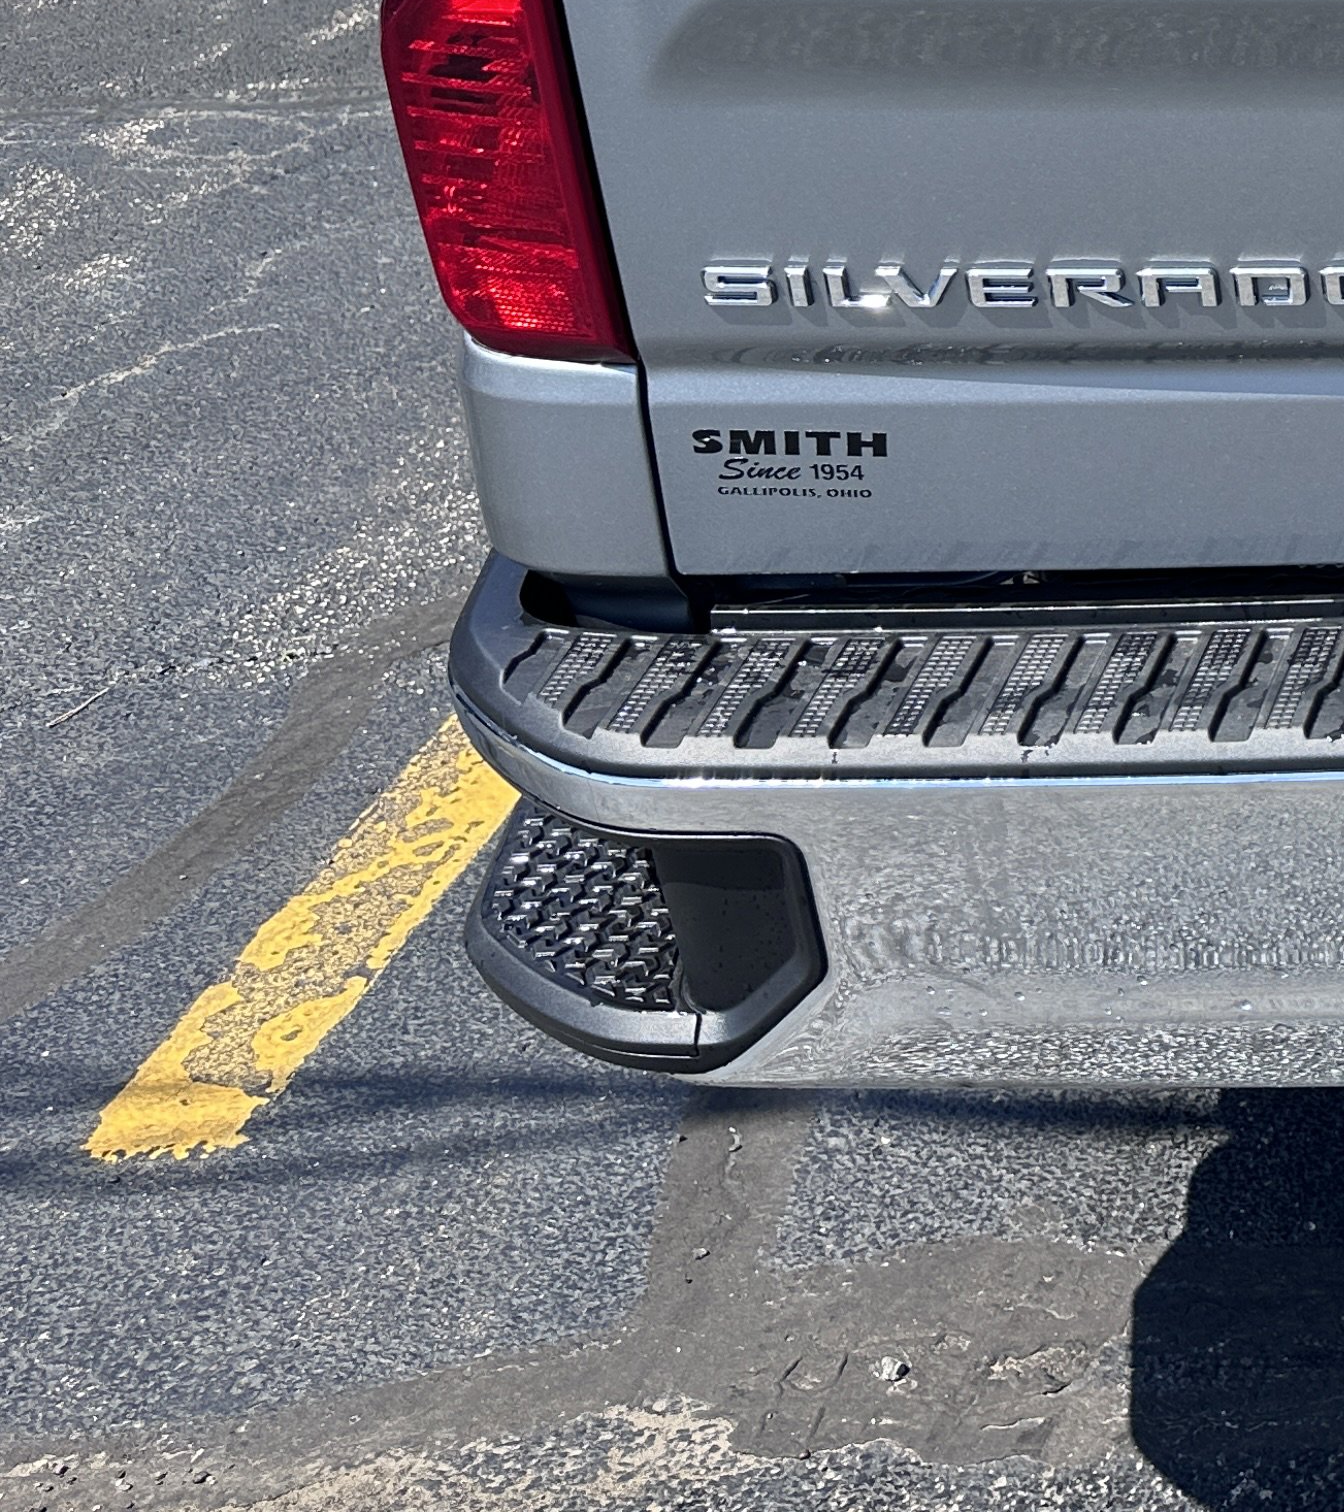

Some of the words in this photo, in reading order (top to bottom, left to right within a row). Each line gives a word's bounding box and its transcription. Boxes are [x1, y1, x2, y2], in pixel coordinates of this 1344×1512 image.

[692, 429, 888, 457] SMITH
[718, 458, 801, 480] Since
[809, 463, 865, 481] 1954
[717, 486, 822, 499] GALLIPOLIS,
[827, 488, 872, 498] OHIO
